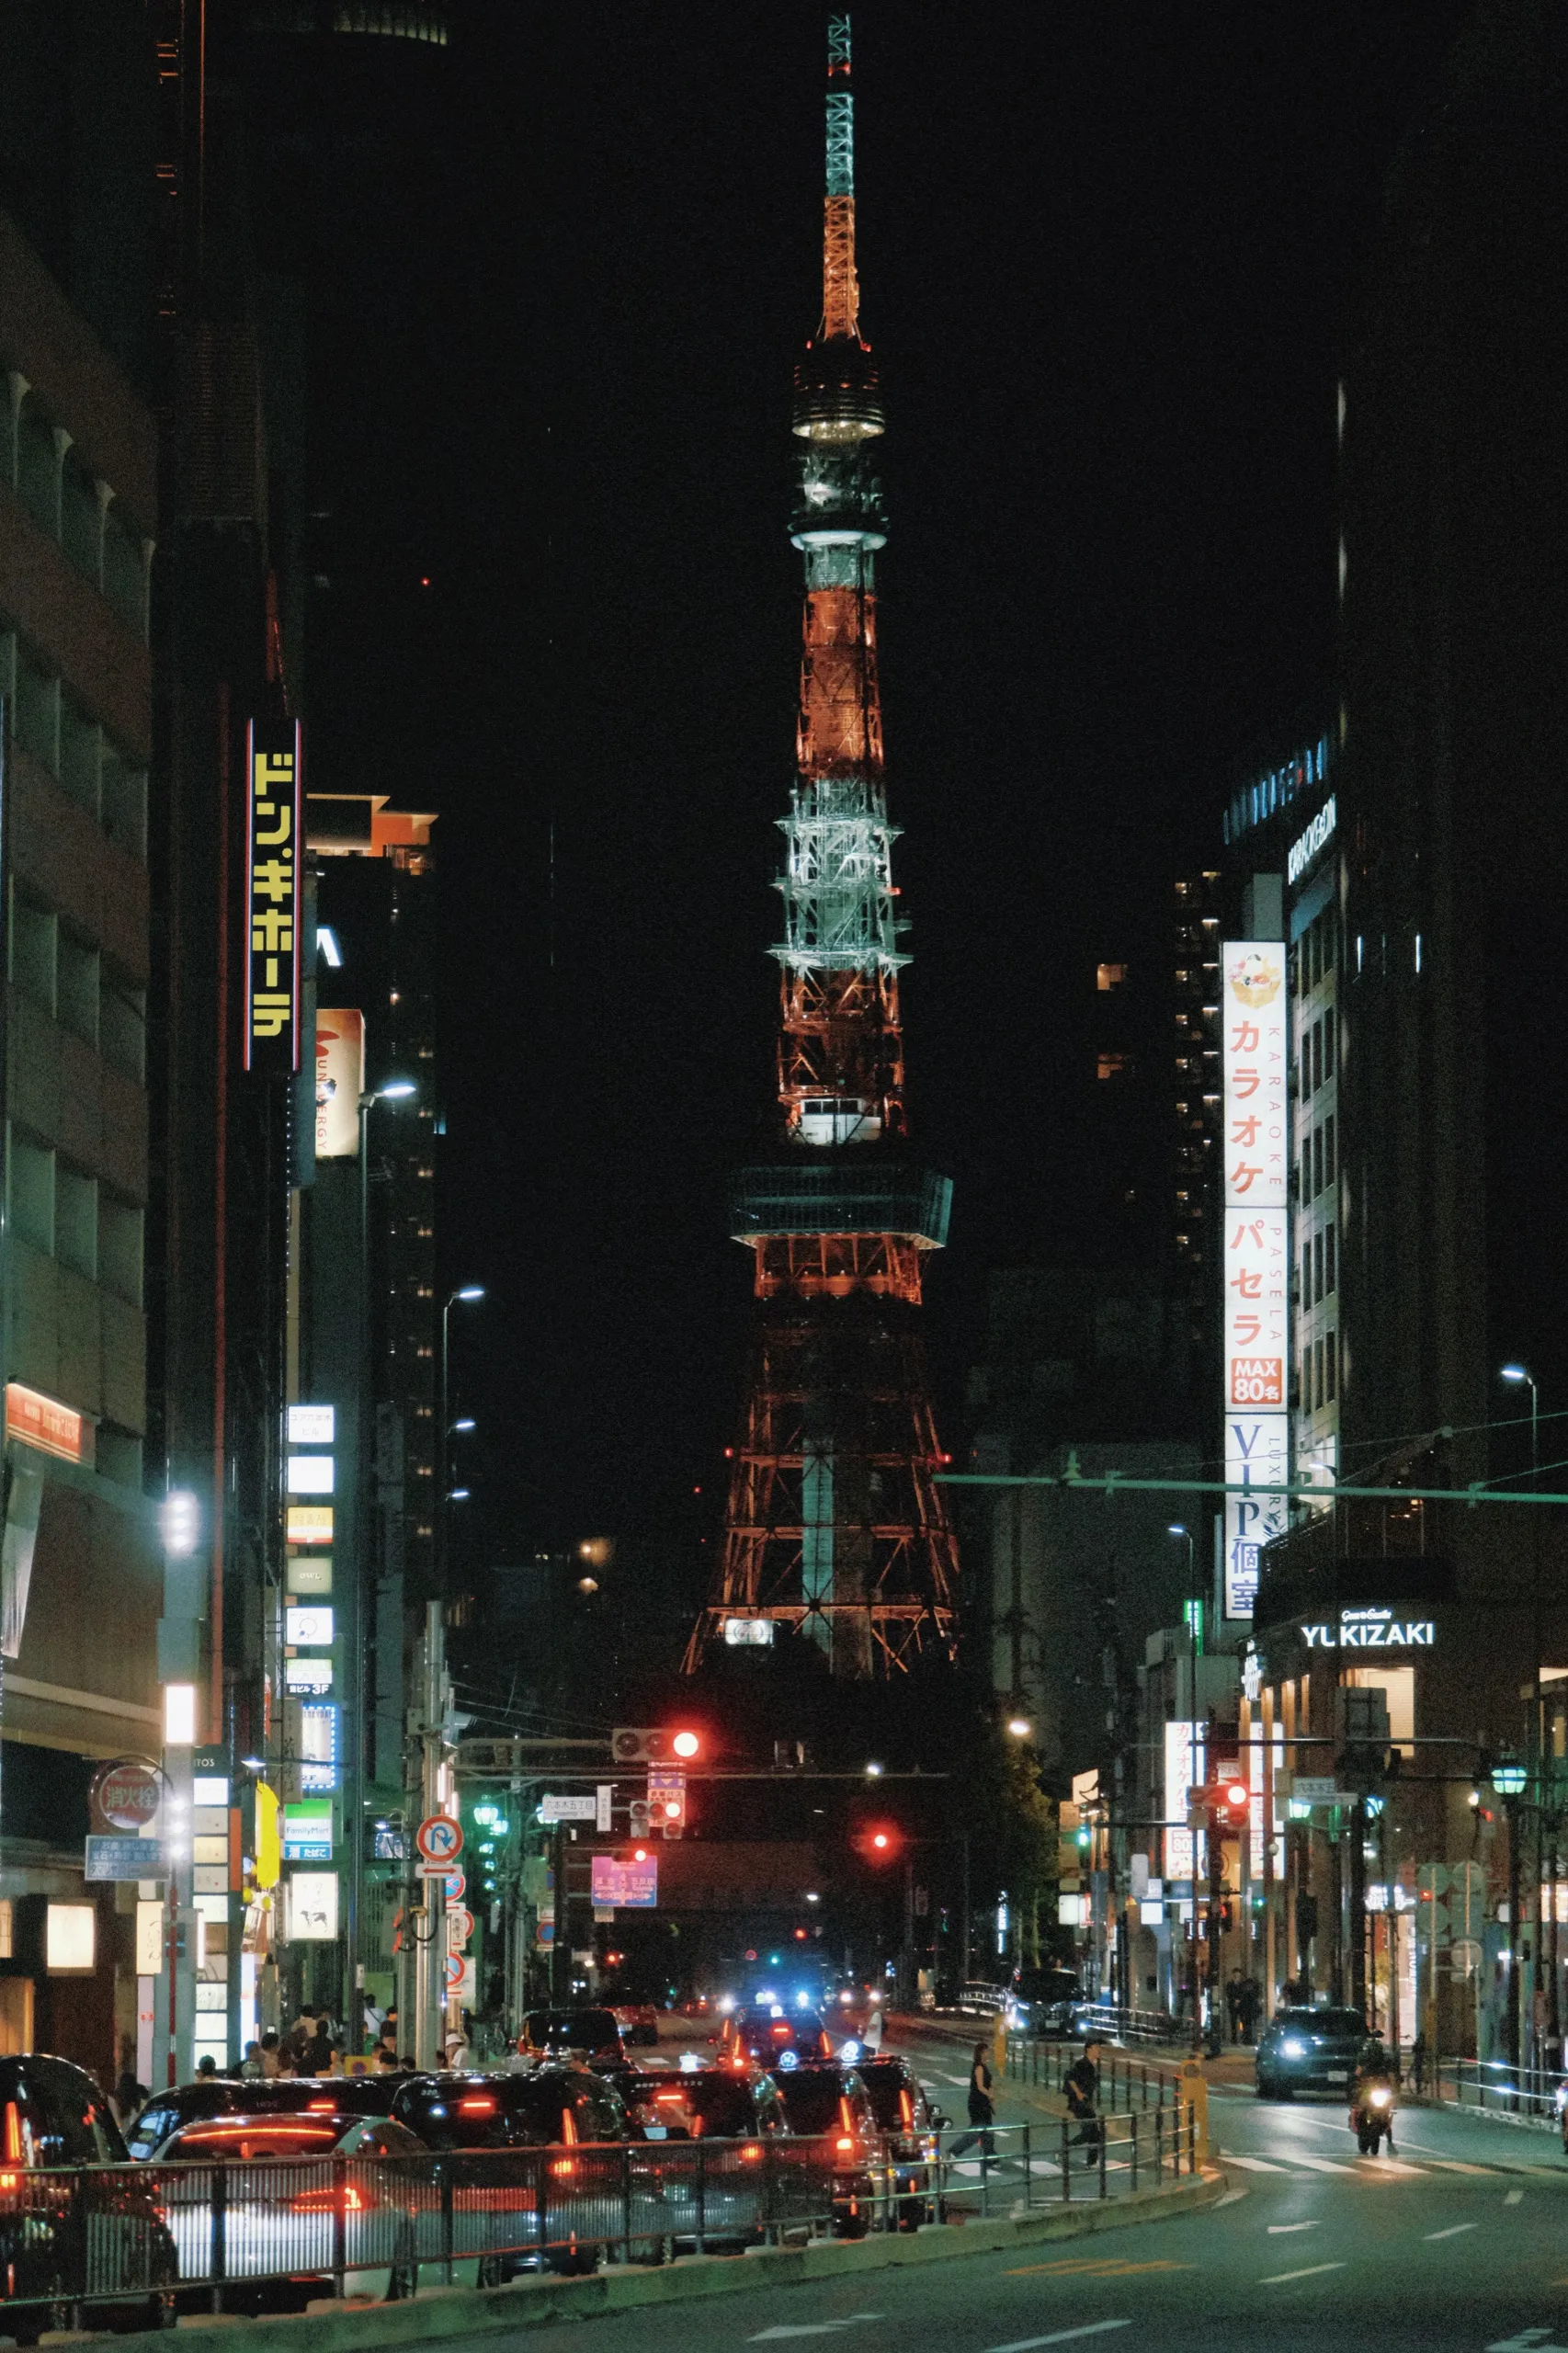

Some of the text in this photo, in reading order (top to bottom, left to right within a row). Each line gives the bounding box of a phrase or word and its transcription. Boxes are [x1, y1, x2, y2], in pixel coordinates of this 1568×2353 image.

[316, 1059, 327, 1149] UNVERGY
[1229, 1020, 1266, 1346] カラオケ パセラ
[1268, 1027, 1283, 1340] KARAOKE PASELA
[1234, 1360, 1278, 1377] MAX
[1233, 1378, 1279, 1402] 80名
[312, 1684, 329, 1695] 3F
[107, 1786, 156, 1808] 消火栓
[544, 1800, 594, 1811] 六本木五丁目
[286, 1825, 329, 1836] FamilyMart
[303, 1847, 326, 1858] たばこ
